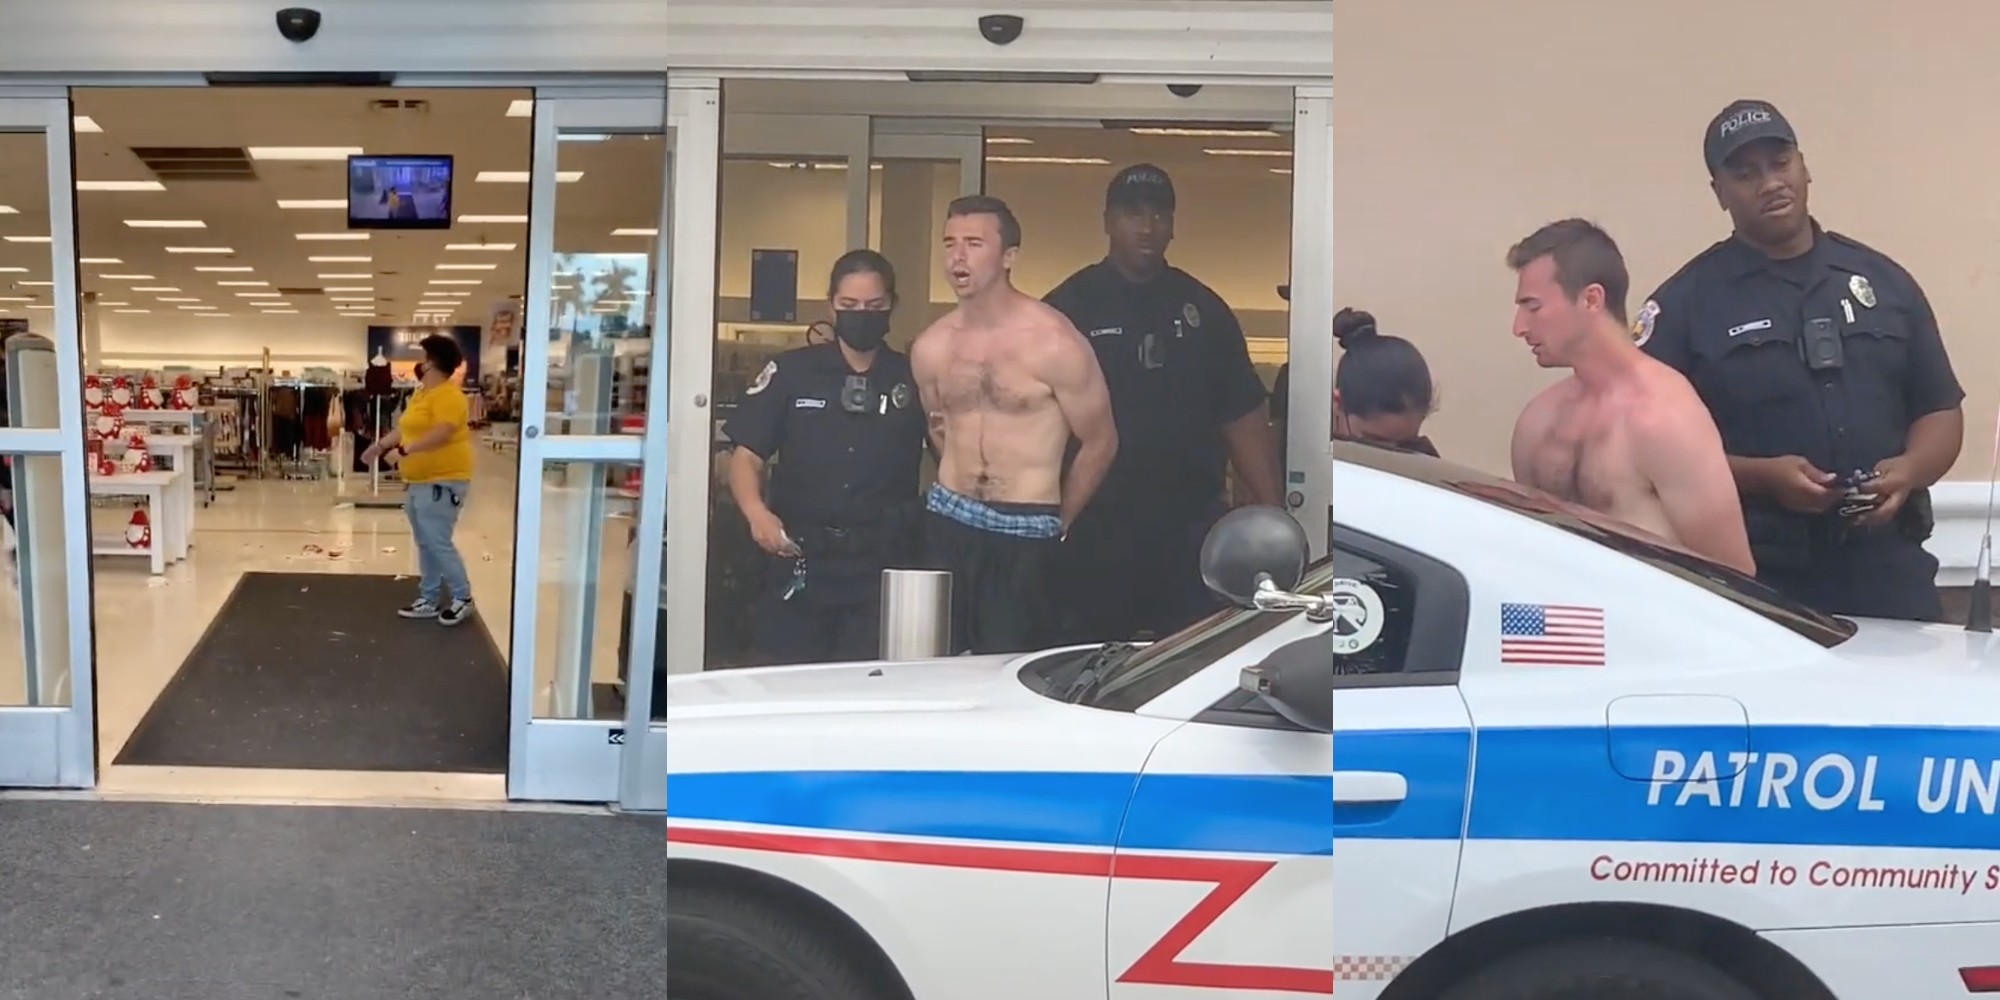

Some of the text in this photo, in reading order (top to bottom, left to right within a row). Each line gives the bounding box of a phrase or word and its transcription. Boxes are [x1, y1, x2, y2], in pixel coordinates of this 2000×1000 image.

[1721, 110, 1771, 138] POLICE
[1647, 750, 1885, 812] PATROL
[1590, 855, 1760, 884] Committed
[1769, 860, 1797, 886] to
[1808, 861, 1977, 895] Community
